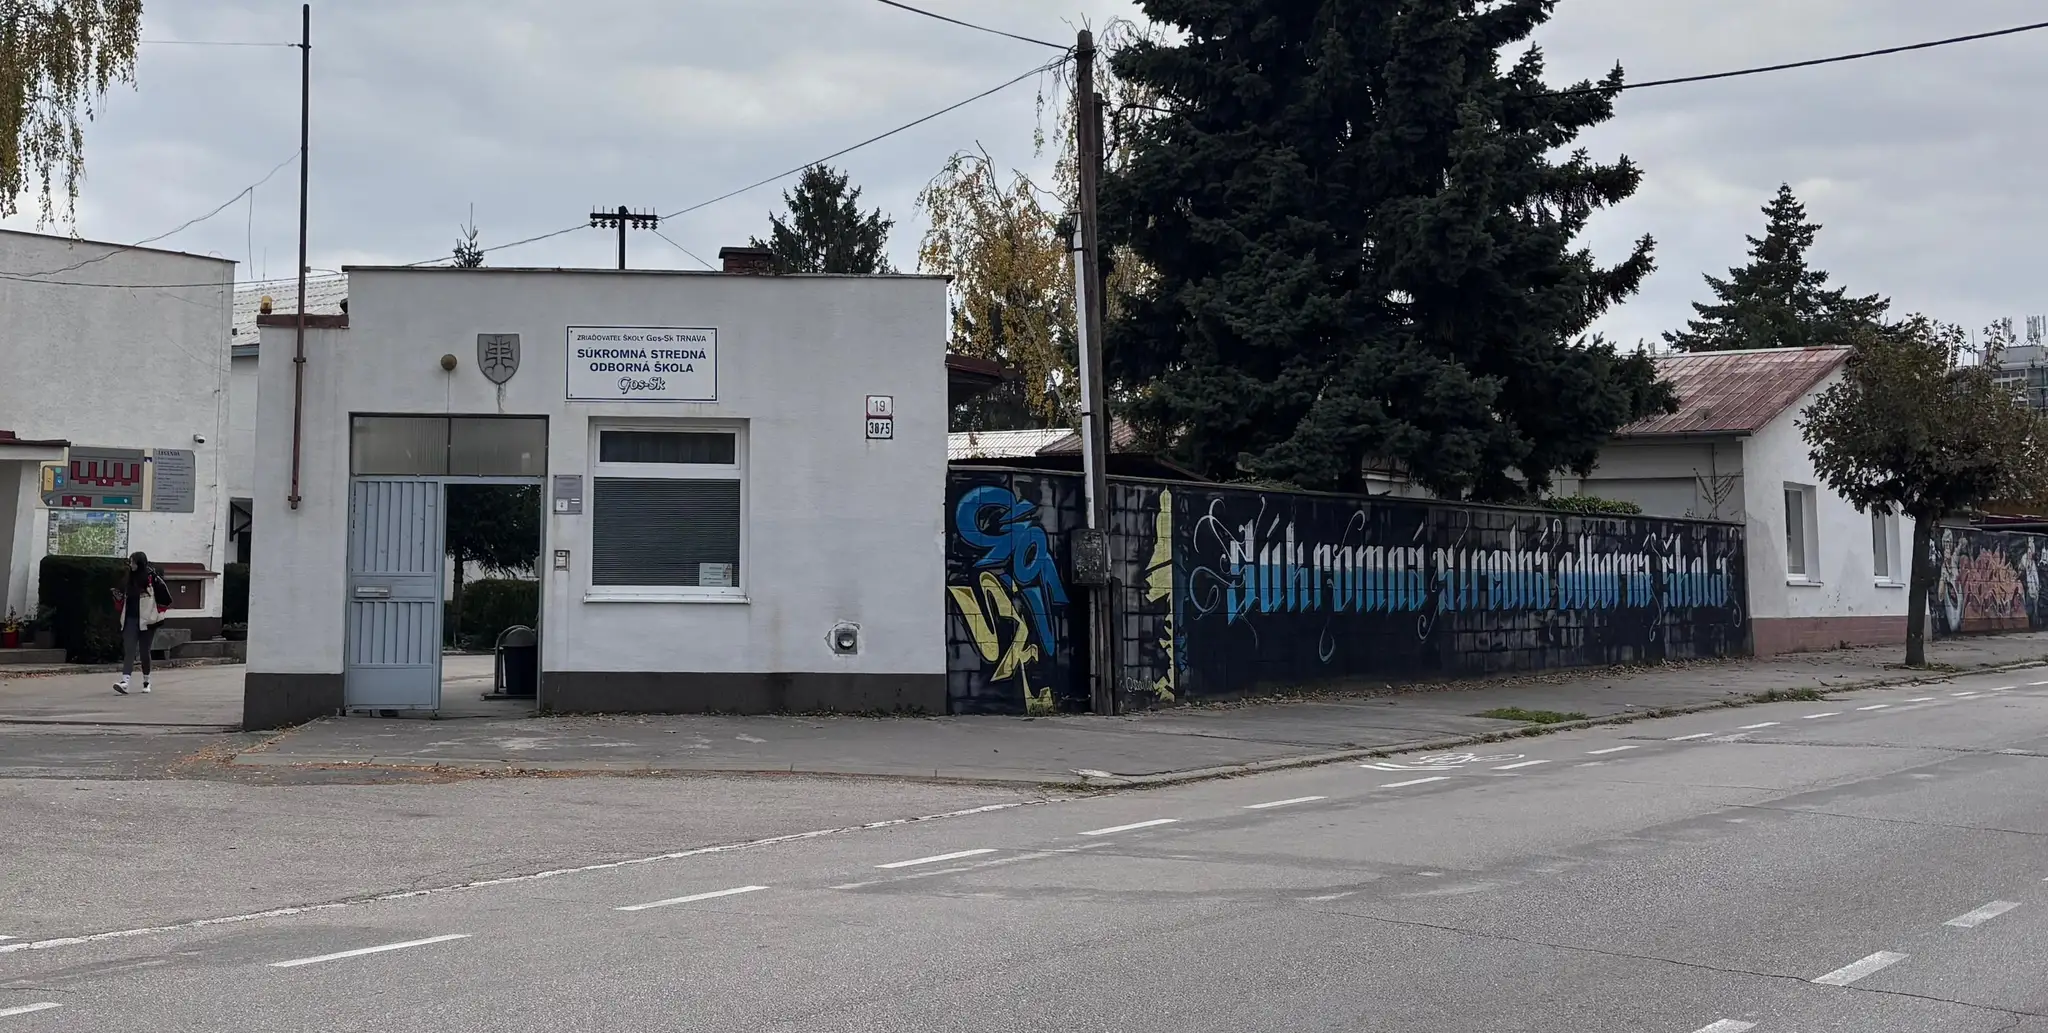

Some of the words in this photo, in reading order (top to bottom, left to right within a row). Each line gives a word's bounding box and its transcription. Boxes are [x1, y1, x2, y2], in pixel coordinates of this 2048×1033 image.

[622, 334, 644, 342] ŠKOLY
[646, 334, 674, 342] Gos-Sk
[676, 334, 706, 342] TRNAVA
[577, 346, 647, 359] SÚKROMNÁ
[650, 347, 706, 360] STREDNÁ
[590, 360, 650, 372] ODBORNÁ
[654, 360, 694, 373] ŠKOLA
[617, 376, 666, 395] Gos-Sk
[874, 400, 886, 412] 19
[869, 421, 890, 435] 3875
